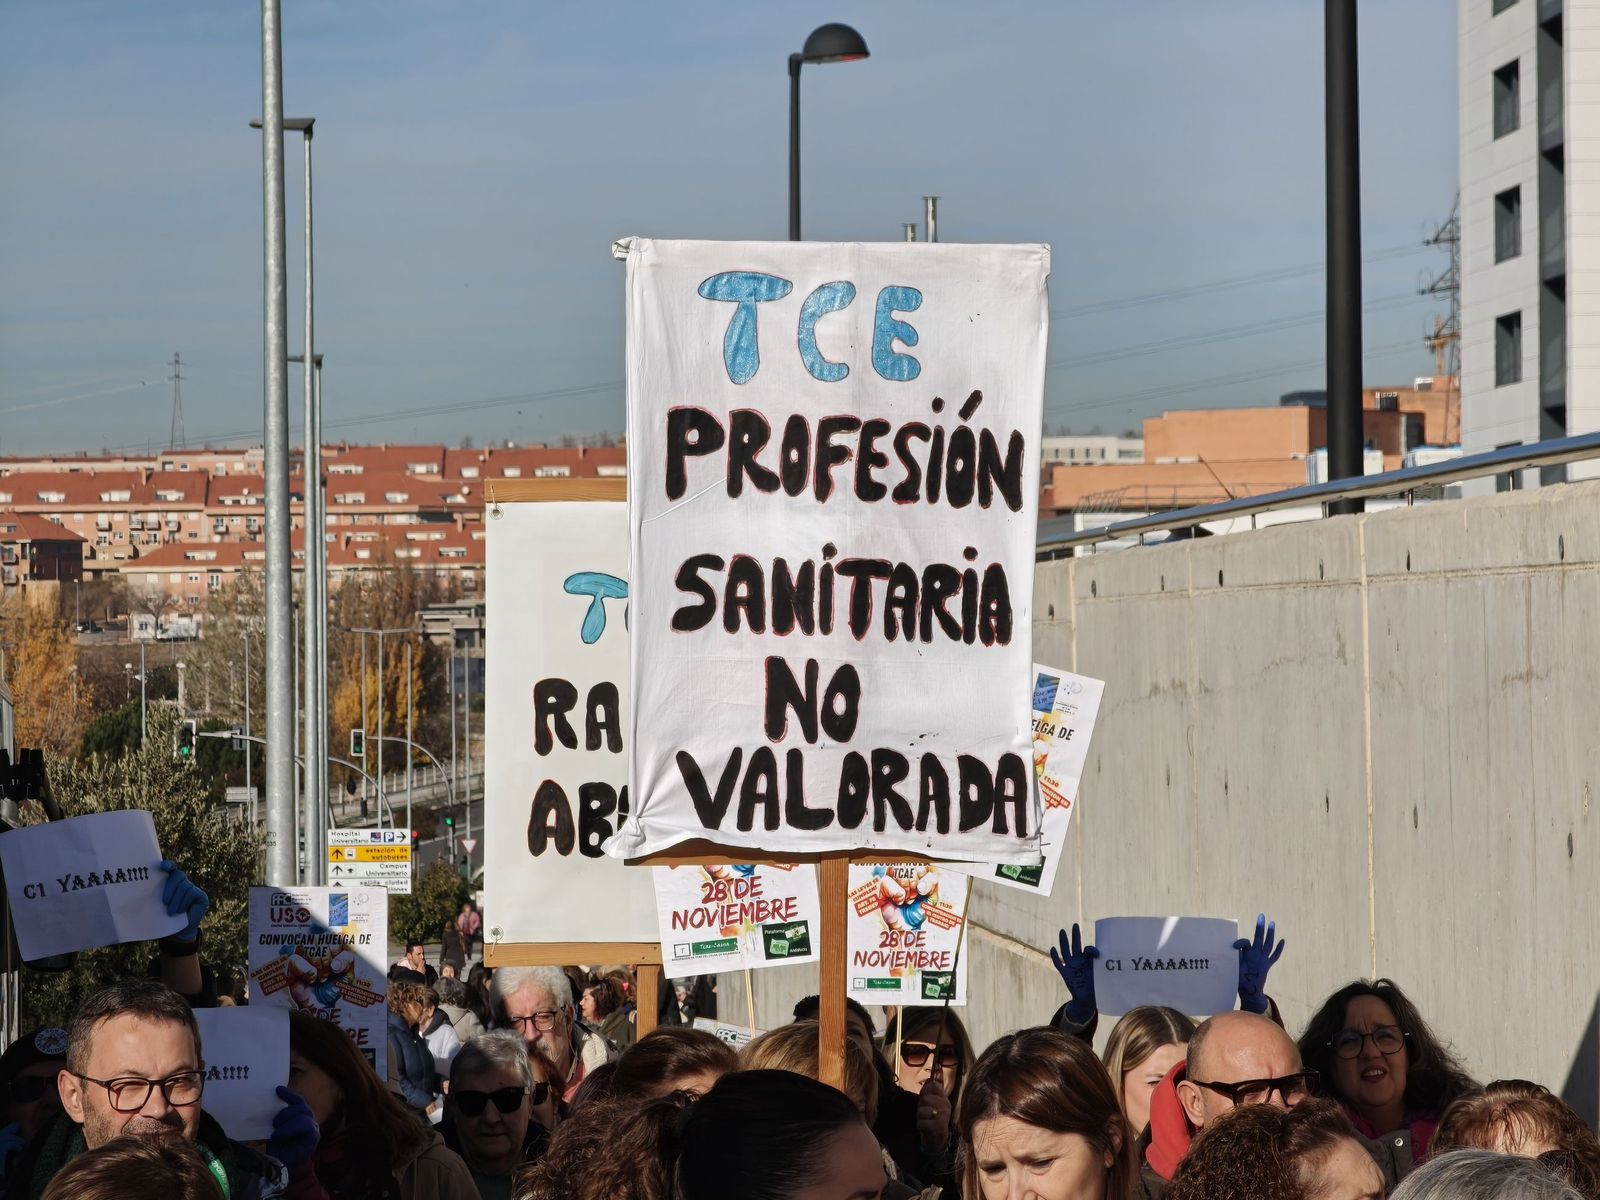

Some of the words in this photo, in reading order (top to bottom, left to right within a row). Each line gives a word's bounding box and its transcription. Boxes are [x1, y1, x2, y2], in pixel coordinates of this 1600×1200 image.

[697, 270, 923, 385] TCE
[563, 571, 629, 645] T
[764, 656, 861, 744] NO
[1032, 719, 1055, 737] ELGA
[1058, 726, 1075, 741] DE
[676, 747, 1029, 838] VALORADA
[527, 779, 629, 859] AB
[893, 867, 915, 879] TCAE
[23, 882, 47, 900] C1
[701, 880, 728, 904] 28
[734, 875, 764, 899] DE
[270, 907, 311, 924] USO
[671, 896, 799, 931] NOVIEMBRE
[259, 933, 315, 945] CONVOCAN
[319, 933, 355, 945] HUELGA
[358, 933, 372, 945] DE
[879, 930, 901, 949] 28
[904, 930, 927, 947] DE
[303, 946, 328, 957] TCAE
[853, 950, 951, 970] NOVIEMBRE
[1105, 958, 1124, 972] C1
[1131, 956, 1210, 971] YAAAA!!!!
[204, 1065, 250, 1080] A!!!!
